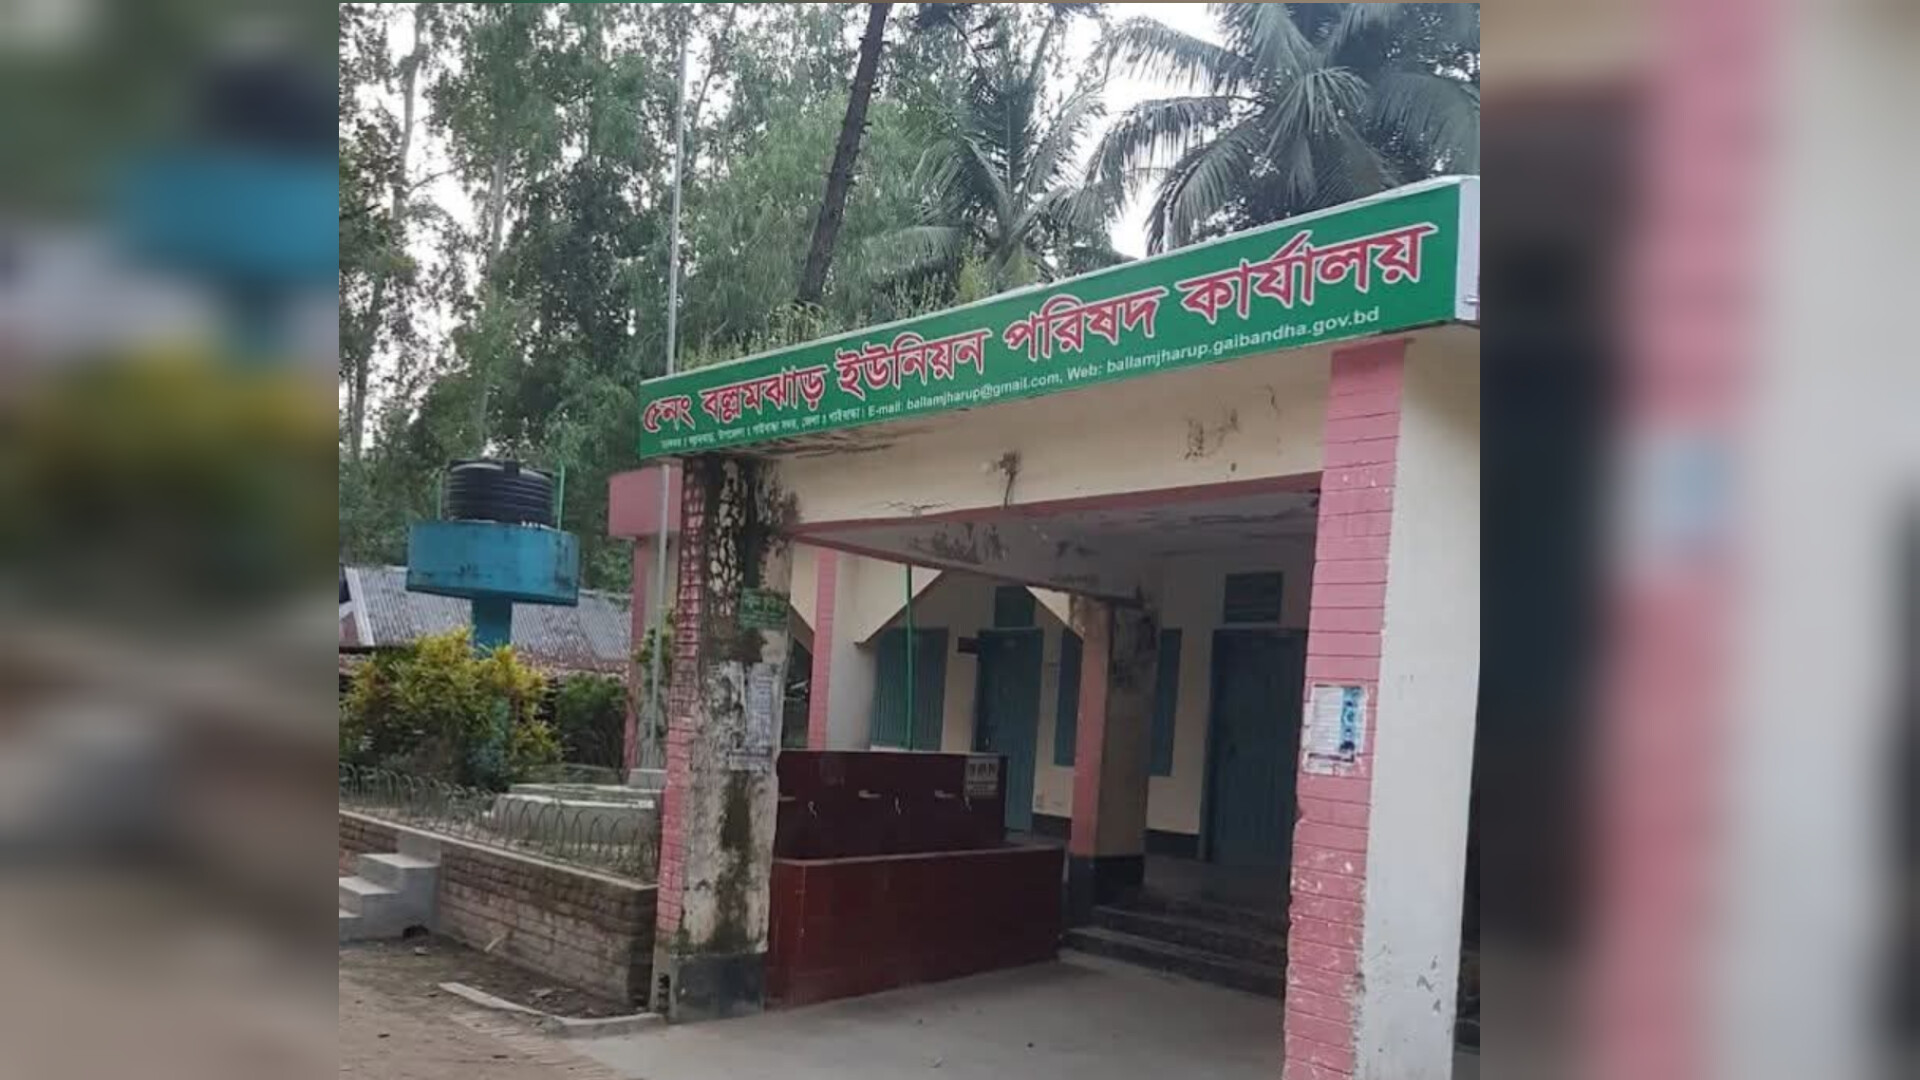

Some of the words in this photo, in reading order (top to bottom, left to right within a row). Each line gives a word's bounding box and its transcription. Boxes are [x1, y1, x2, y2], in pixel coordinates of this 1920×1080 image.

[643, 395, 695, 432] ৫নং
[701, 365, 828, 423] বল্লমঝাড়
[835, 329, 992, 400] ইউনিয়ন
[1003, 286, 1169, 360] পরিষদ
[1176, 223, 1438, 324] কার্যালয়
[868, 402, 903, 418] E-mail:
[1067, 363, 1102, 382] Web:
[1106, 306, 1380, 374] ballamjharup.gaibandha.gov.bd
